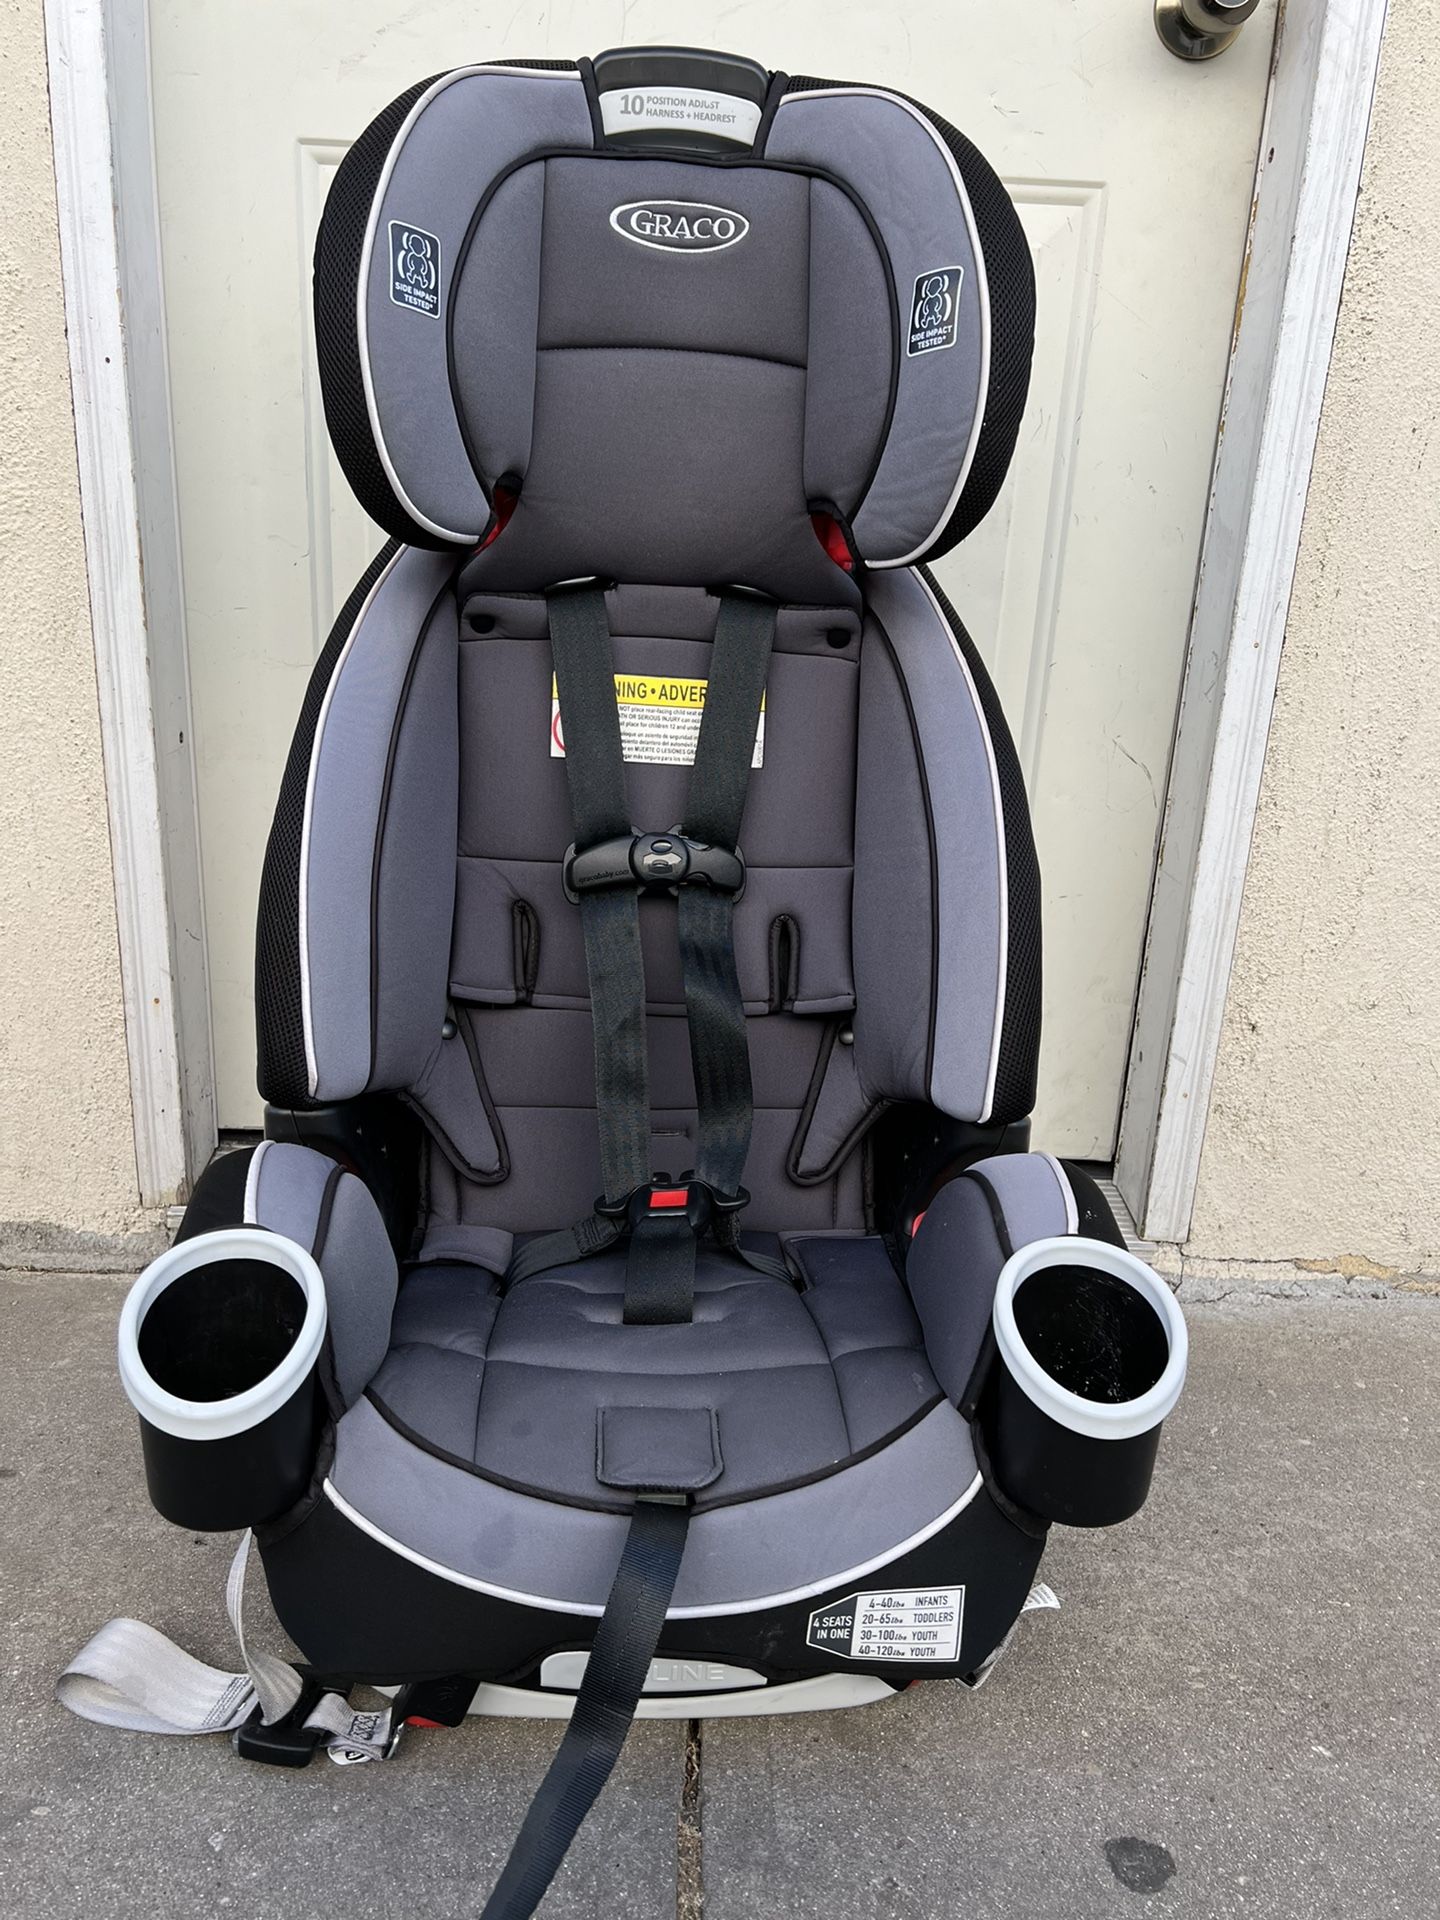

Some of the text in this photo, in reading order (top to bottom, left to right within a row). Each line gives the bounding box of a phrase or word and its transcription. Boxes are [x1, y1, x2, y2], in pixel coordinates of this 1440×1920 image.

[620, 94, 645, 116] 10
[646, 96, 720, 110] POSITION ADJUST
[646, 108, 685, 119] HARNESS
[693, 112, 737, 124] HEADREST
[630, 209, 736, 239] GRACO
[395, 282, 437, 304] SIDE IMPACT
[911, 325, 952, 342] SIDE IMPACT
[616, 681, 707, 703] NING ADVER
[915, 1595, 948, 1607] INFANTS
[812, 1615, 853, 1628] 4 SEATS
[913, 1611, 954, 1623] TODDLERS
[816, 1628, 851, 1640] IN ONE
[912, 1630, 938, 1641] YOUTH
[910, 1647, 936, 1657] YOUTH
[653, 1663, 725, 1682] LINE
